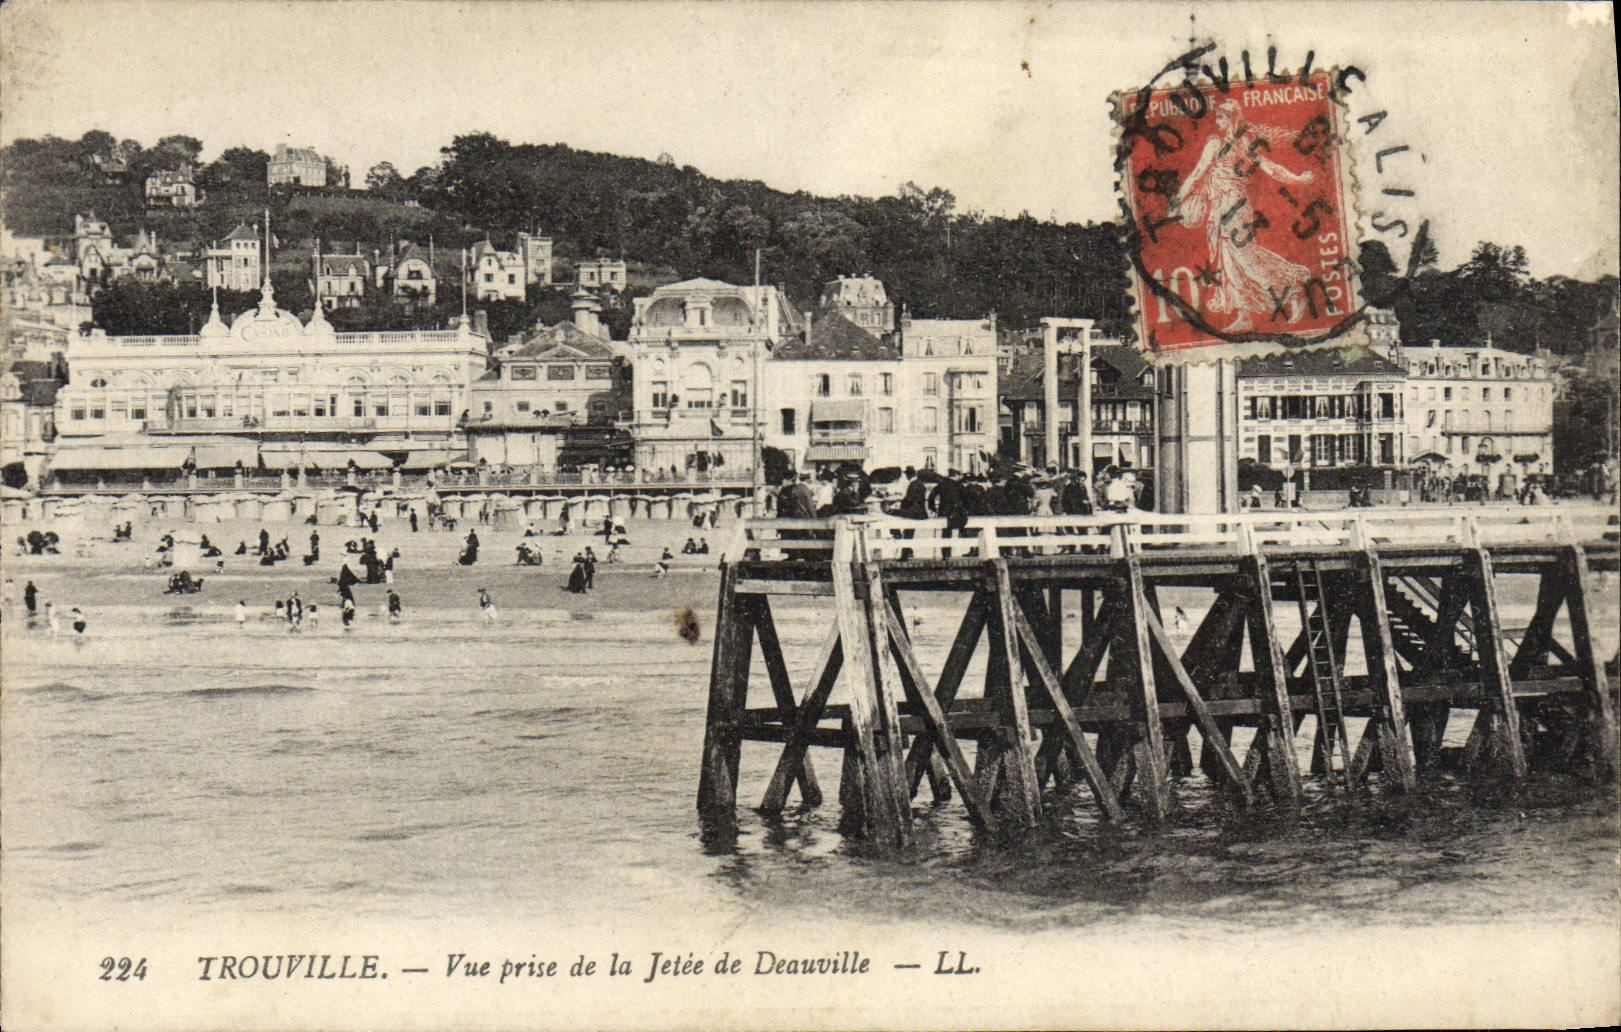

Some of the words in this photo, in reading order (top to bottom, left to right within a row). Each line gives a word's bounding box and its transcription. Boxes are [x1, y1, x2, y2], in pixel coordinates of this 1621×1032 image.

[1243, 83, 1325, 106] FRANÇAISE
[1149, 266, 1199, 323] 10
[1319, 232, 1345, 317] POSTES
